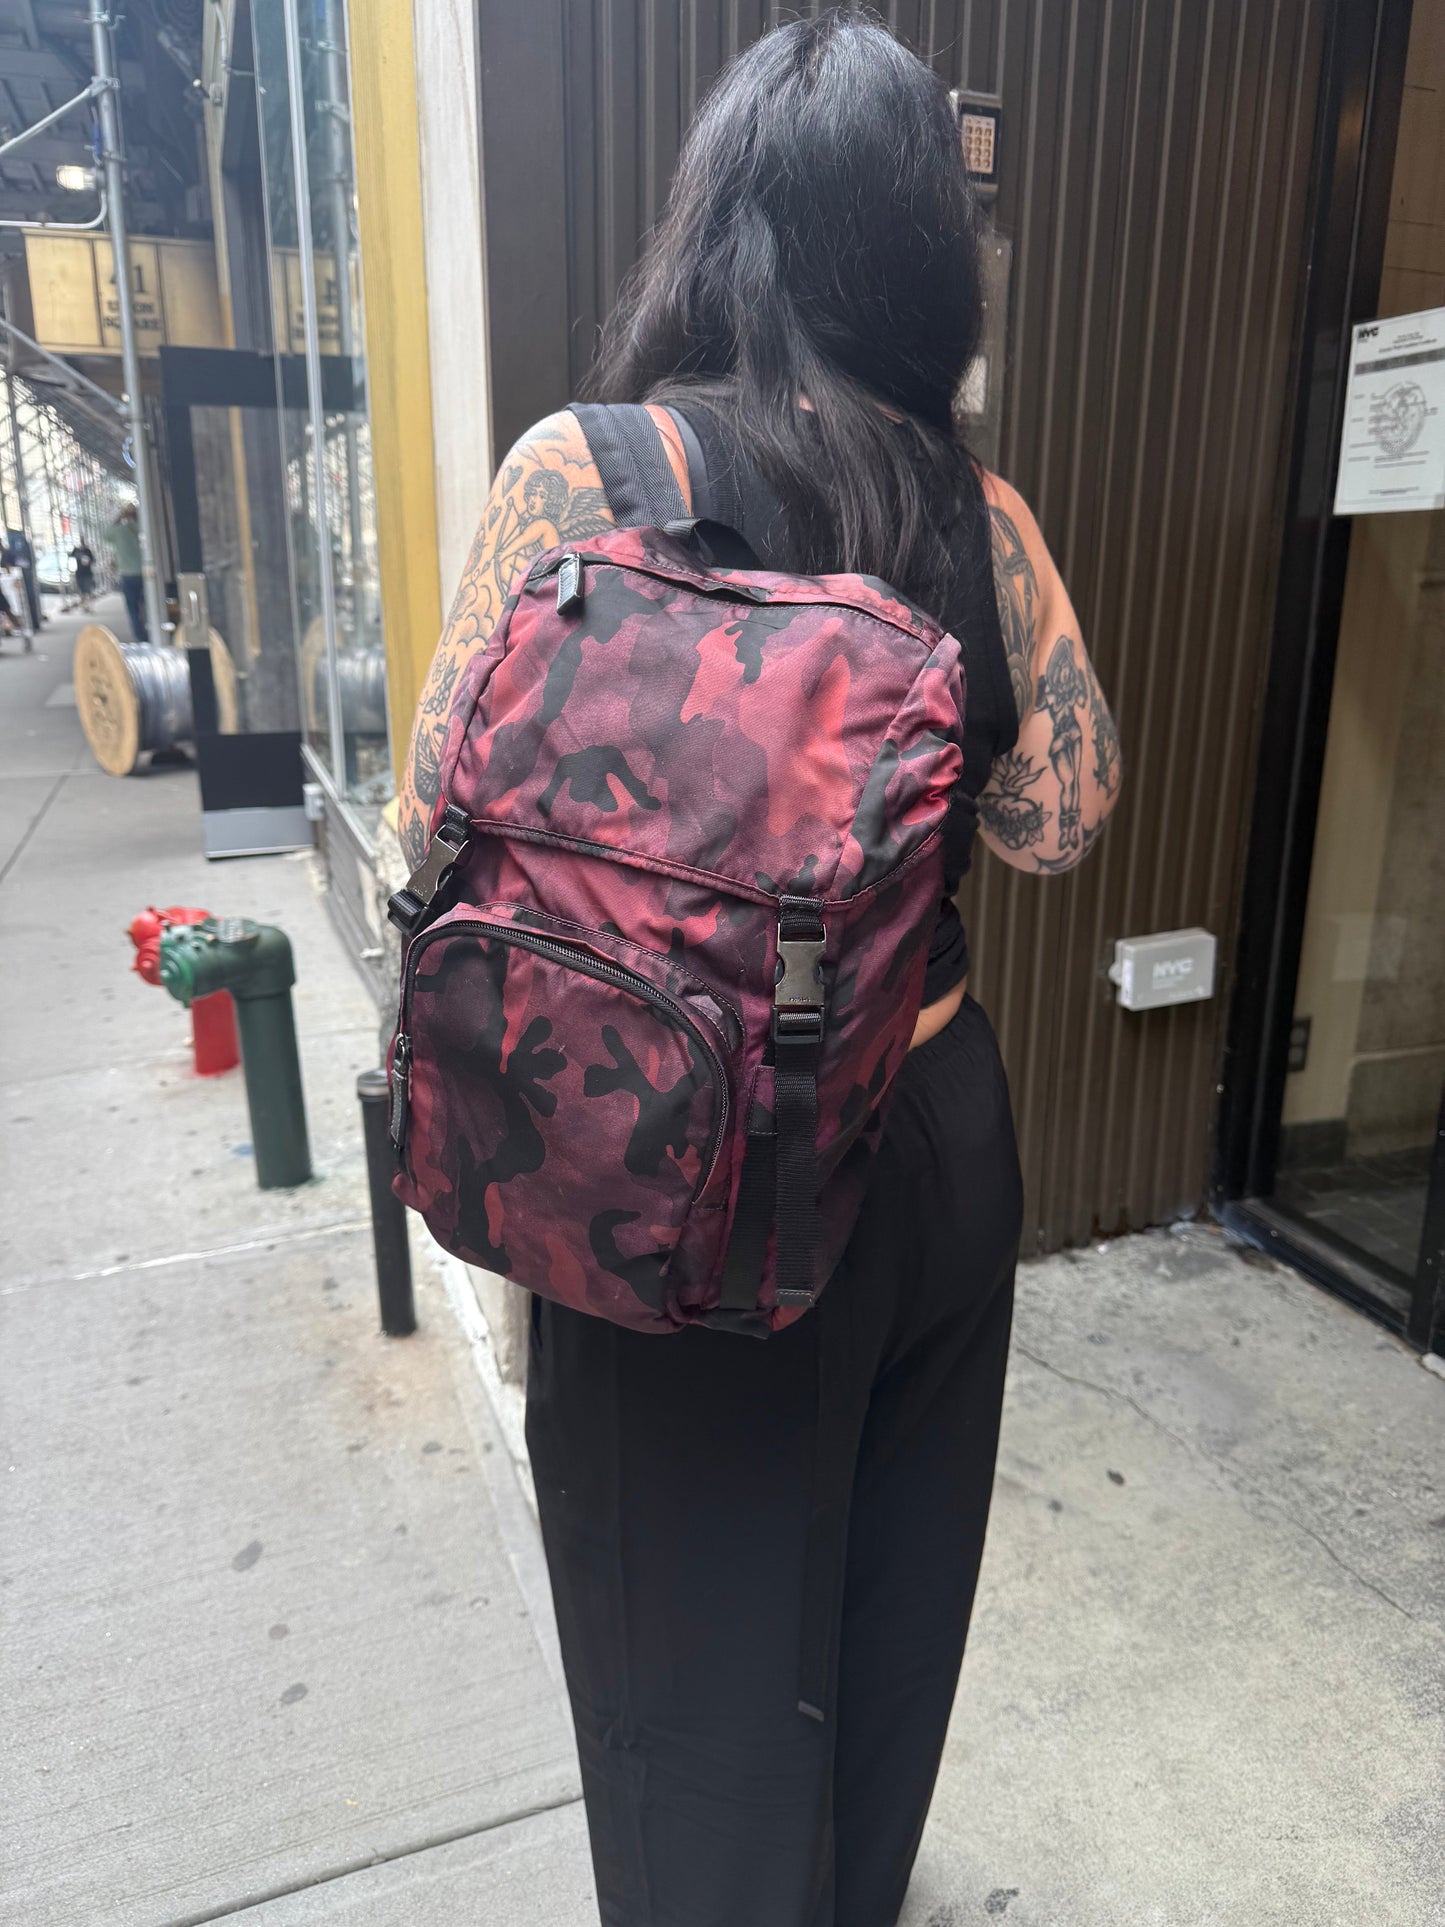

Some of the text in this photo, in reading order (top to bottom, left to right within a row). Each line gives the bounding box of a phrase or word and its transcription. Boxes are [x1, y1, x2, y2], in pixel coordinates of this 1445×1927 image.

[103, 317, 160, 331] SQARE
[1358, 327, 1379, 339] NYC
[1152, 958, 1193, 977] NYC
